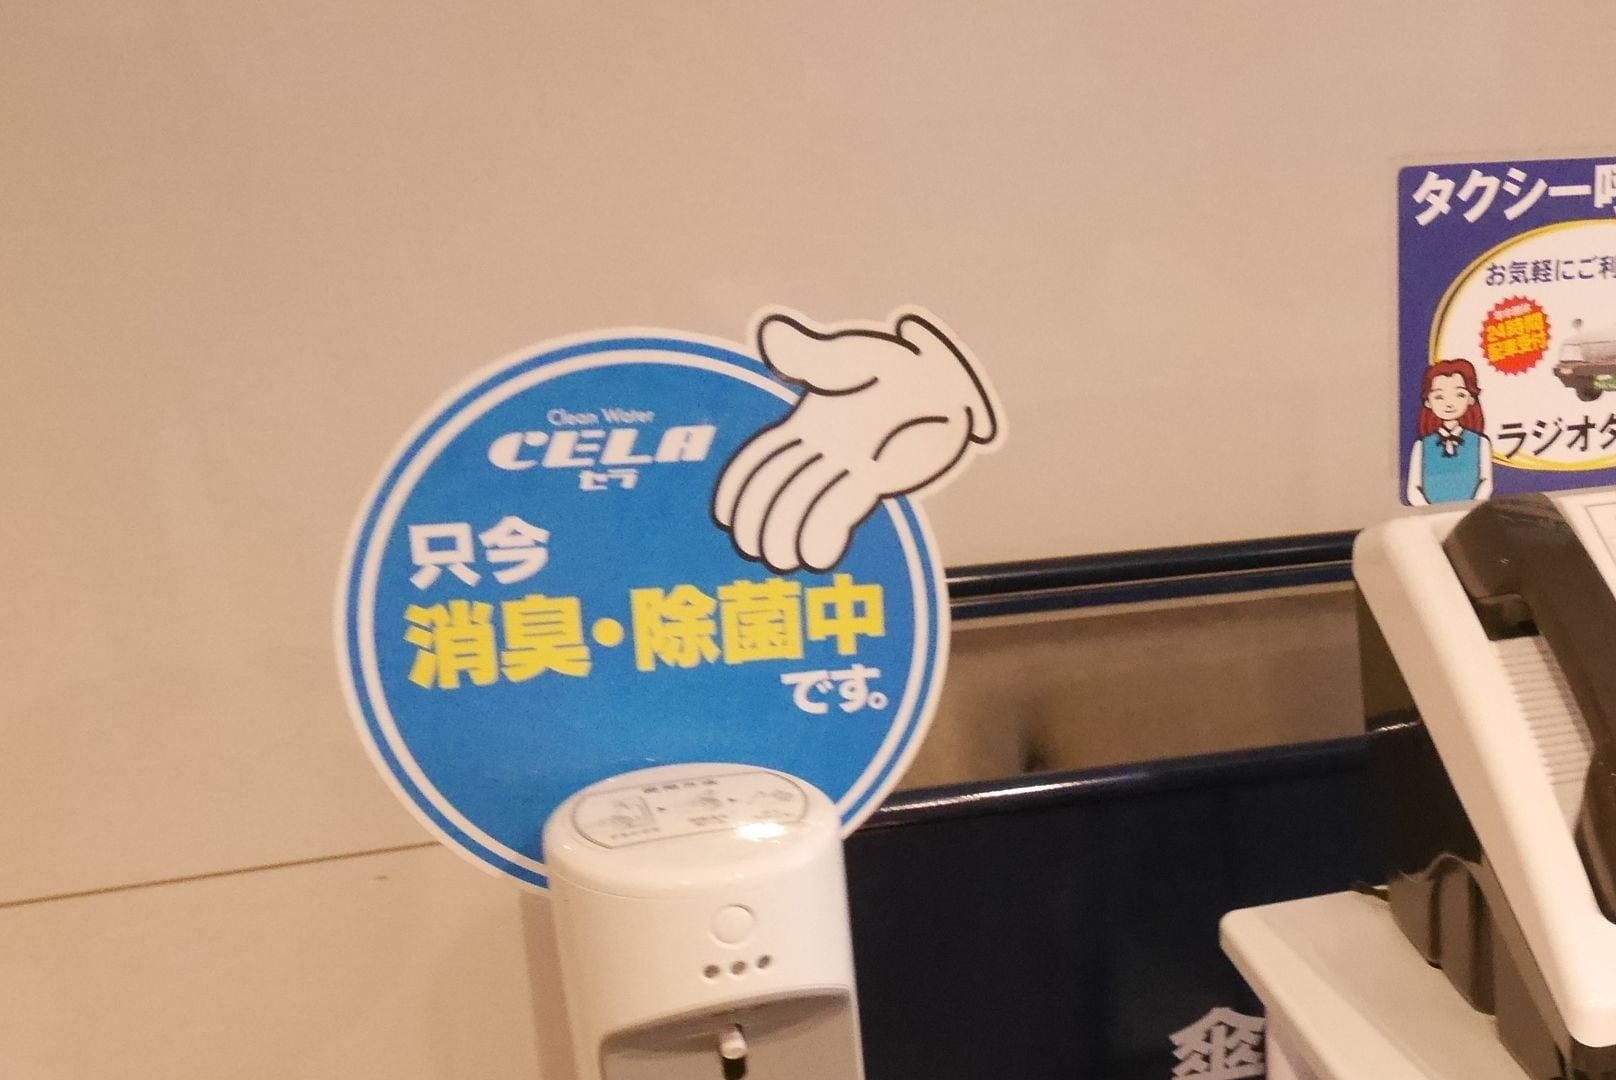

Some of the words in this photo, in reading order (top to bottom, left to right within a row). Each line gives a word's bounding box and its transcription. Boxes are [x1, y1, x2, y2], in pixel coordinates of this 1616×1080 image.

[547, 407, 599, 426] Clean
[601, 407, 656, 424] Water
[487, 423, 718, 471] CELA
[578, 468, 640, 491] セラ
[406, 514, 552, 591] 只今
[402, 572, 886, 690] 消臭・除菌中
[780, 663, 890, 715] です。
